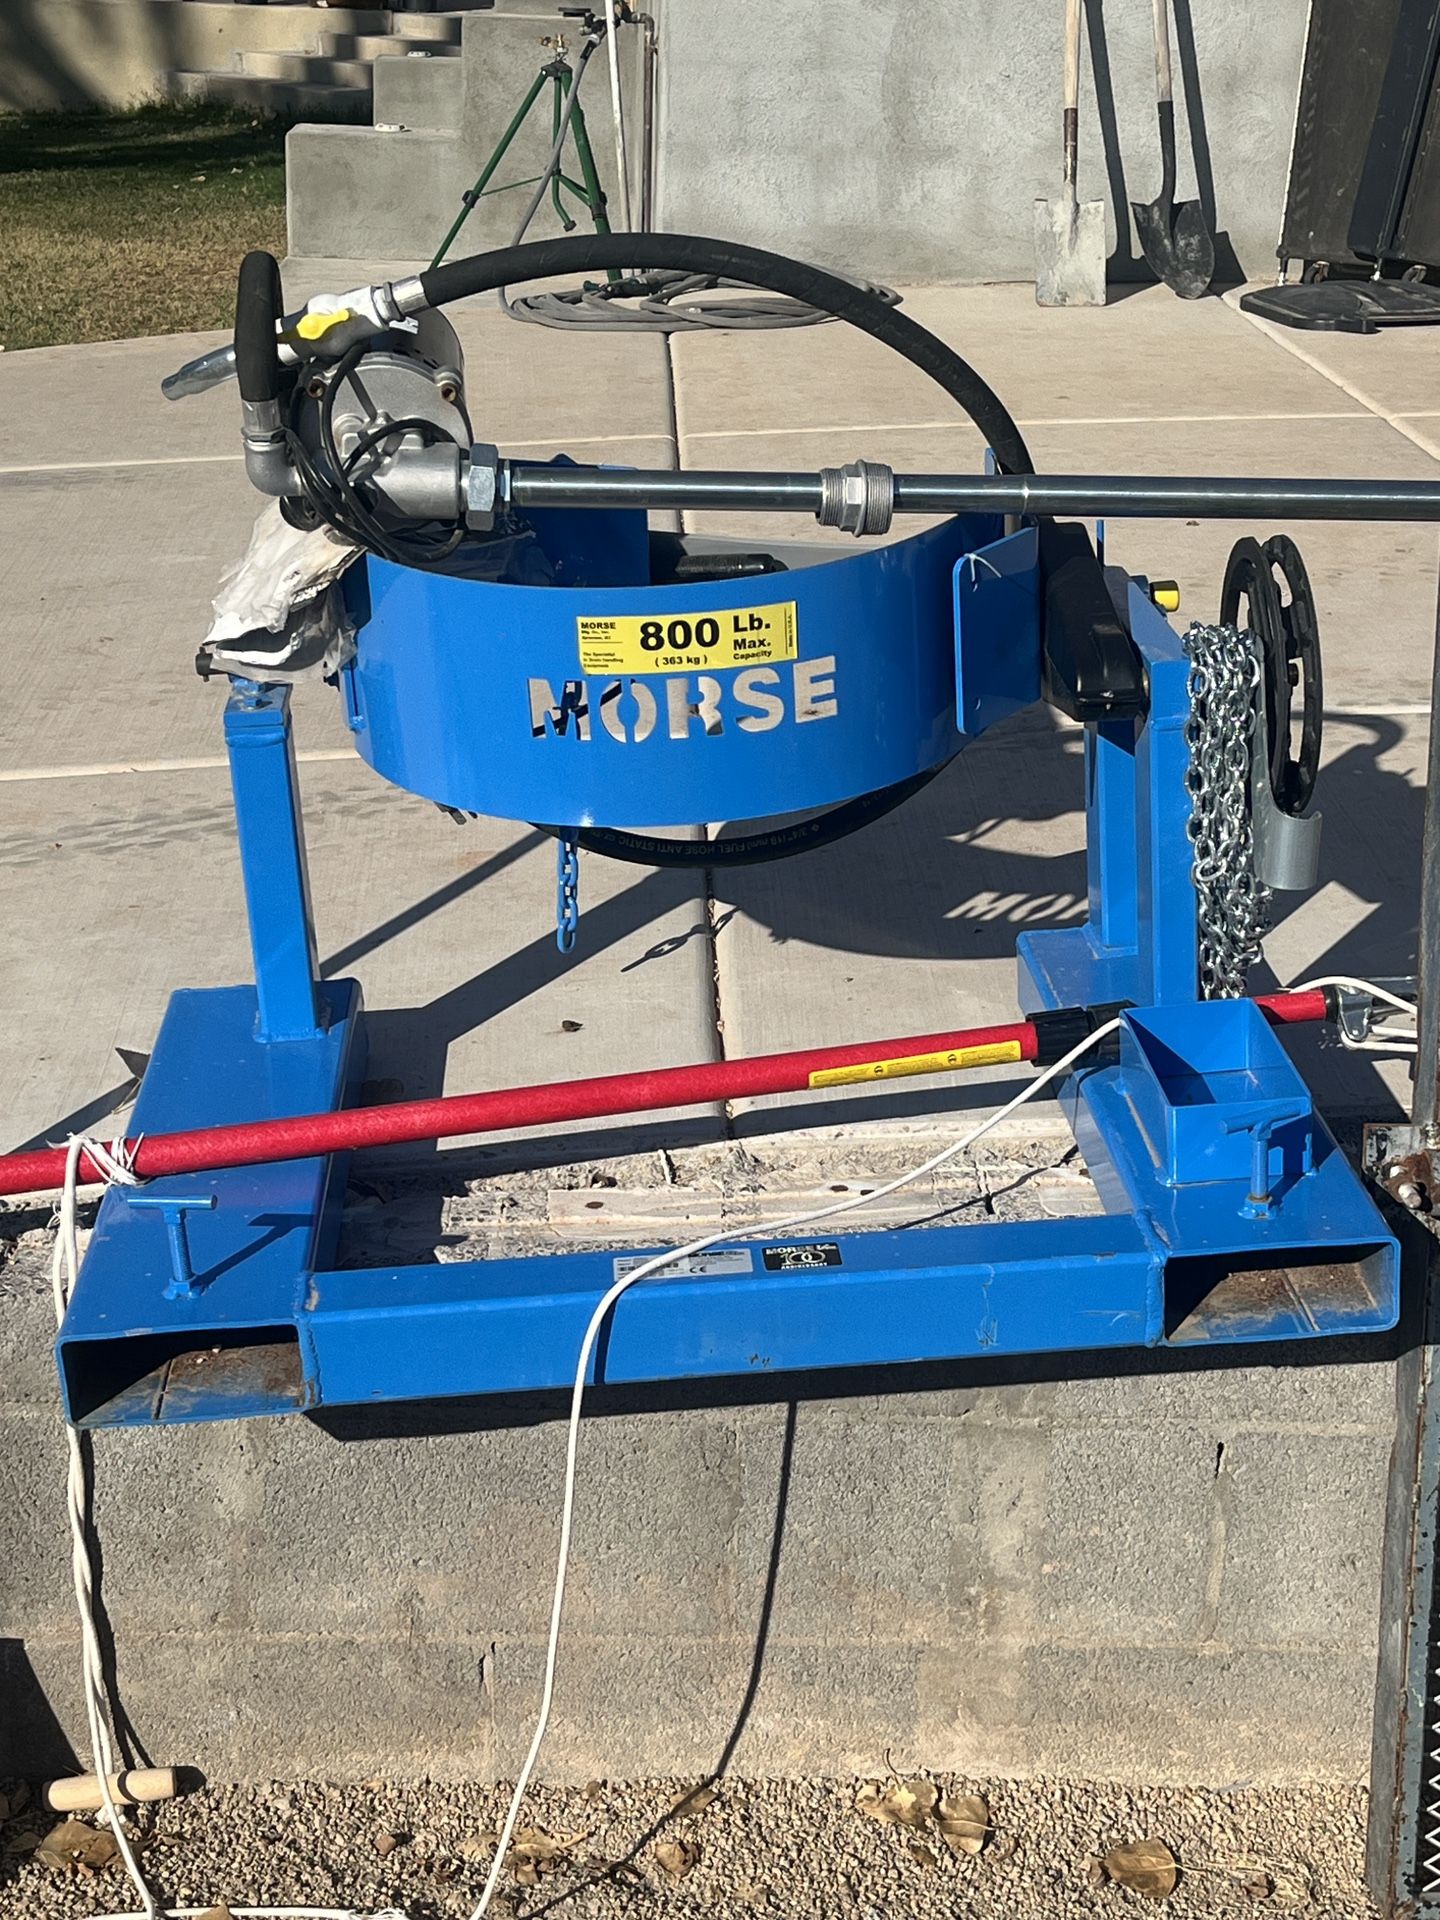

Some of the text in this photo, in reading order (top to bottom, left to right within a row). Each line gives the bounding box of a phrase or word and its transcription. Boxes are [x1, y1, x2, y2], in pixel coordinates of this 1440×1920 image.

[581, 621, 616, 630] MORSE
[733, 613, 771, 633] Lb.
[640, 617, 720, 651] 800
[733, 638, 771, 651] Max.
[733, 650, 773, 661] Capacity
[527, 655, 838, 744] MORSE
[617, 835, 656, 851] STATIC
[657, 842, 682, 854] ANTI
[685, 844, 715, 855] HOSE
[717, 841, 745, 855] FUEL
